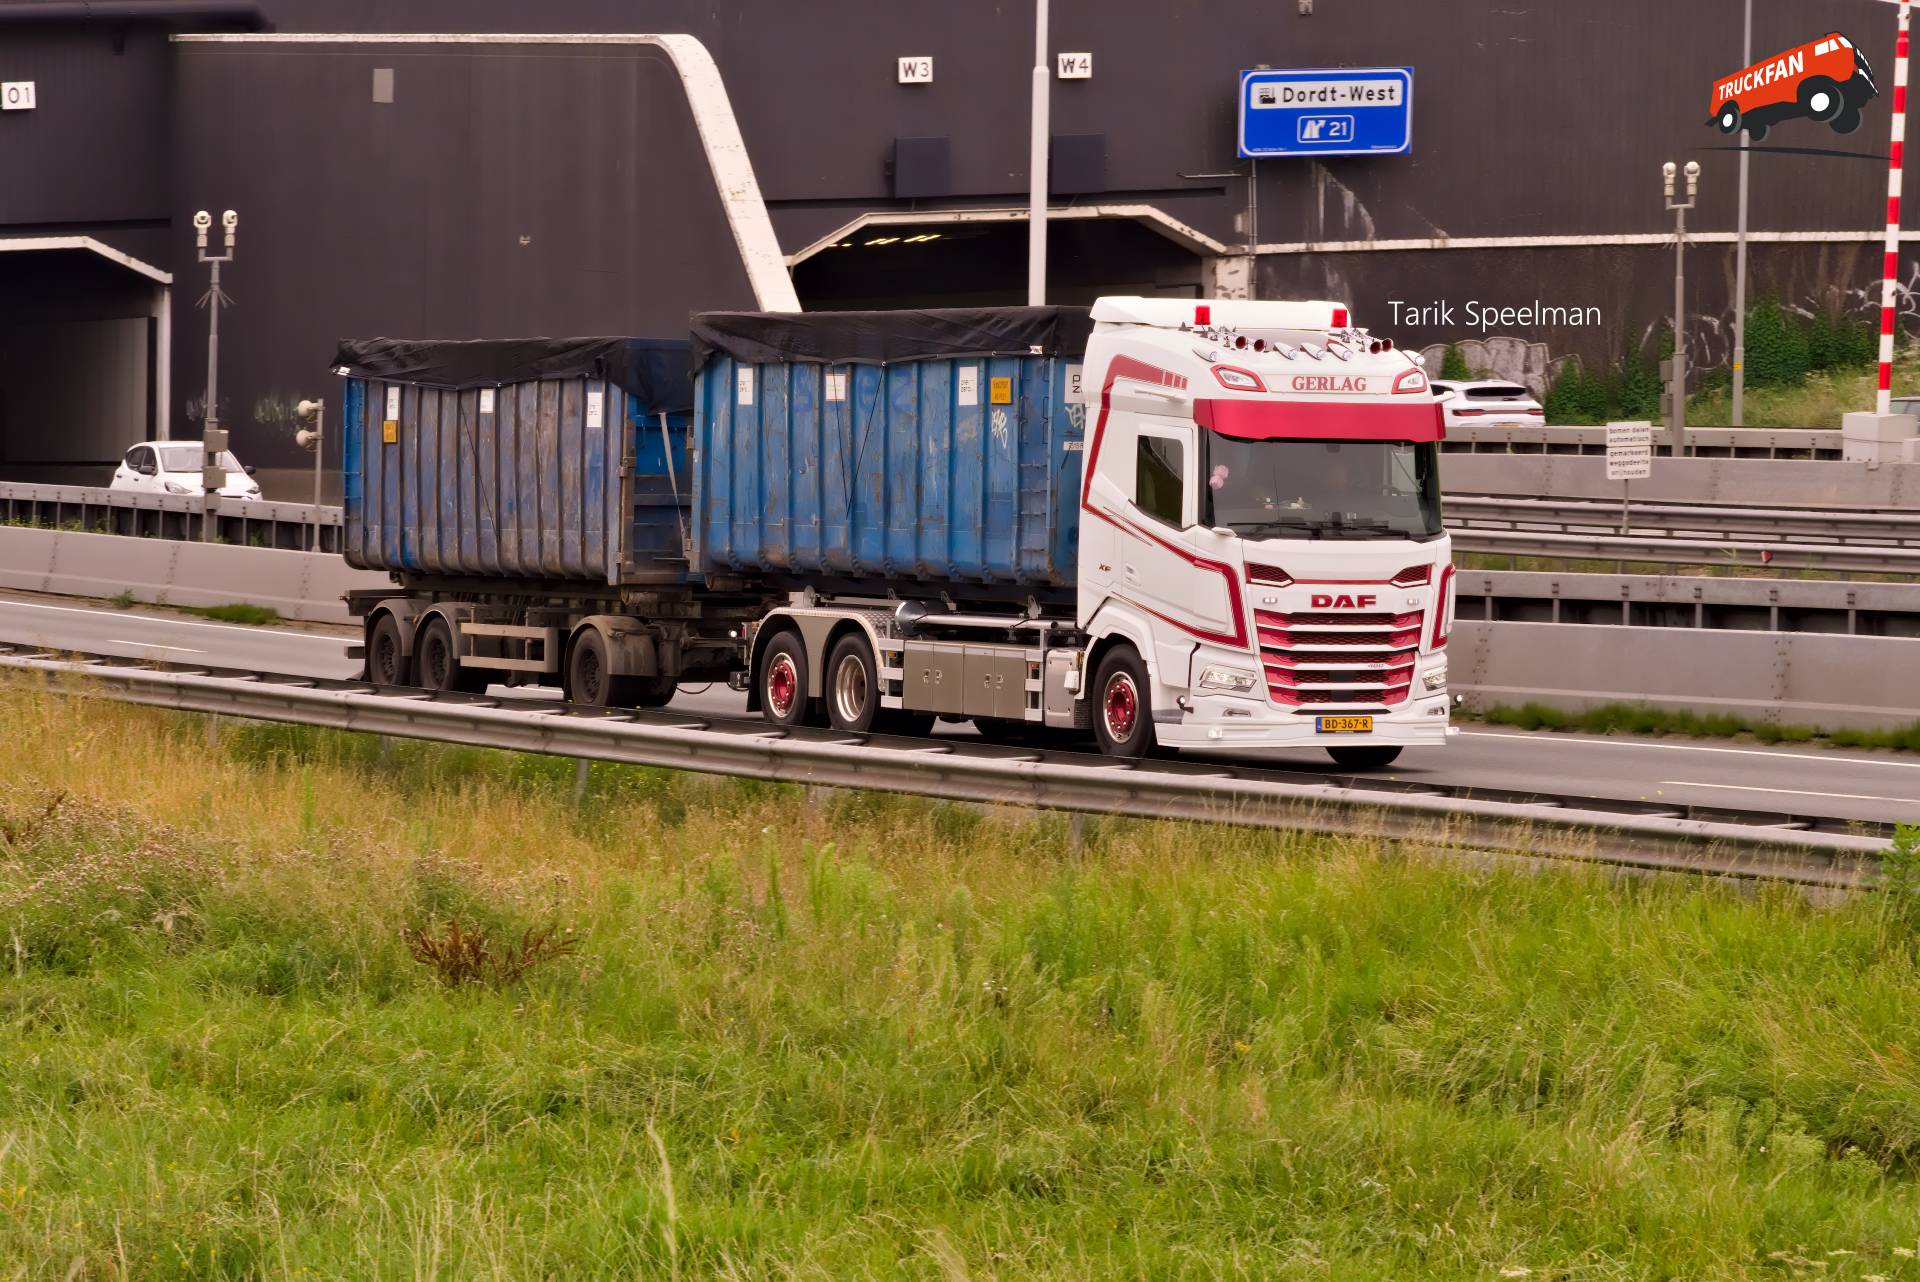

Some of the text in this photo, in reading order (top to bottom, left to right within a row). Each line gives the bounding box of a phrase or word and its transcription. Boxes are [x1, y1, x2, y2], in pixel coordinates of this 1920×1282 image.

[1283, 86, 1396, 103] Dordt-West
[1329, 121, 1347, 136] 21
[1291, 376, 1367, 392] GERLAG
[1311, 594, 1377, 608] DAF
[1324, 719, 1369, 729] BD-367-R
